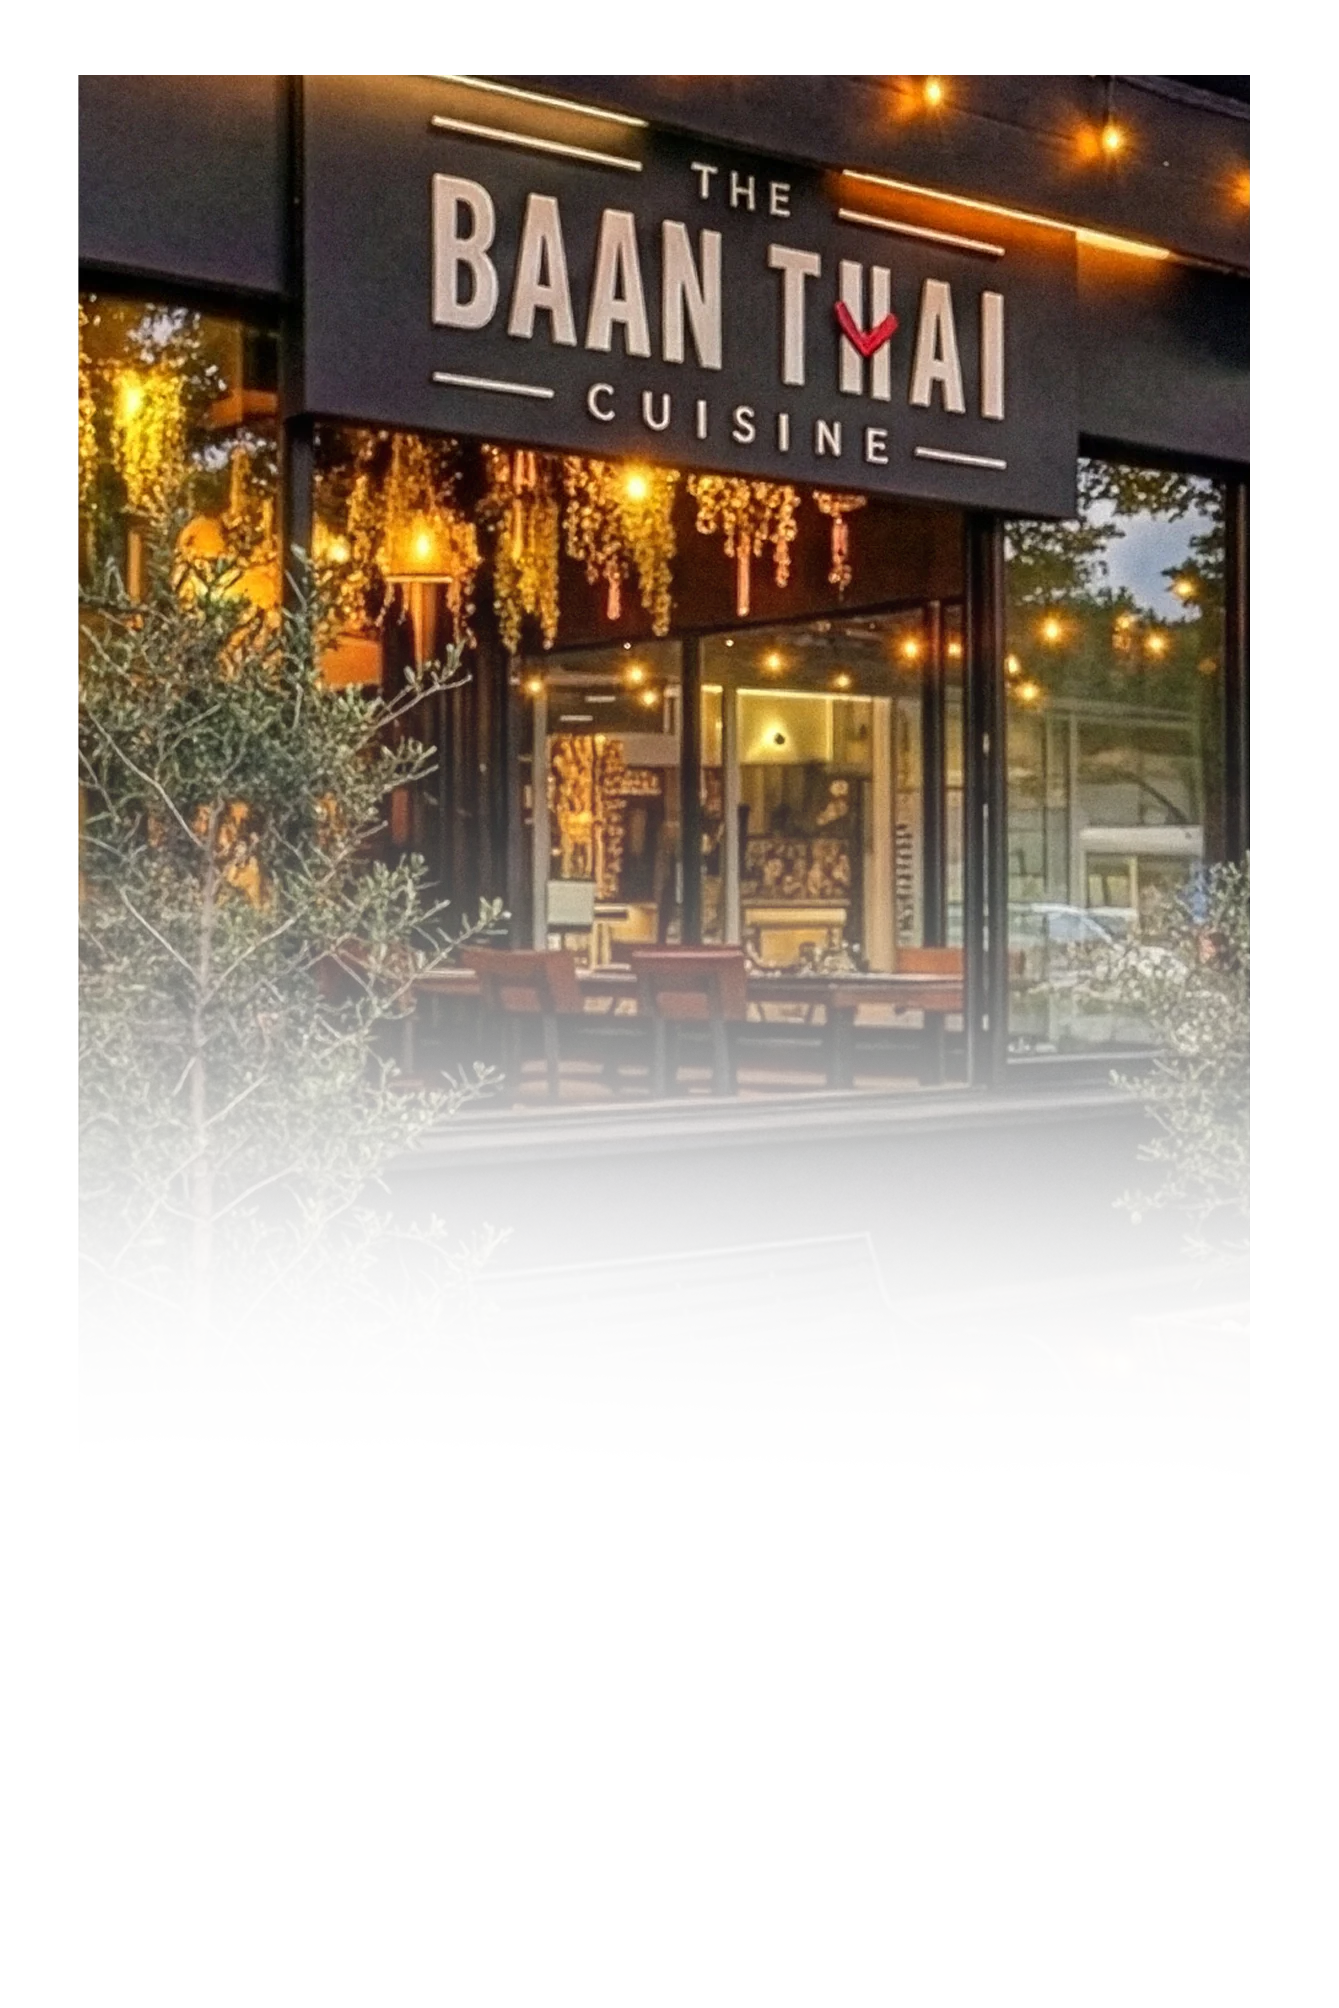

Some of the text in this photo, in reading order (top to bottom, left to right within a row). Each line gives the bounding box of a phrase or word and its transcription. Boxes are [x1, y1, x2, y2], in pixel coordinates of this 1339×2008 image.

[691, 162, 791, 217] THE
[432, 172, 1006, 420] BAAN THAI
[587, 383, 889, 465] CUISINE
